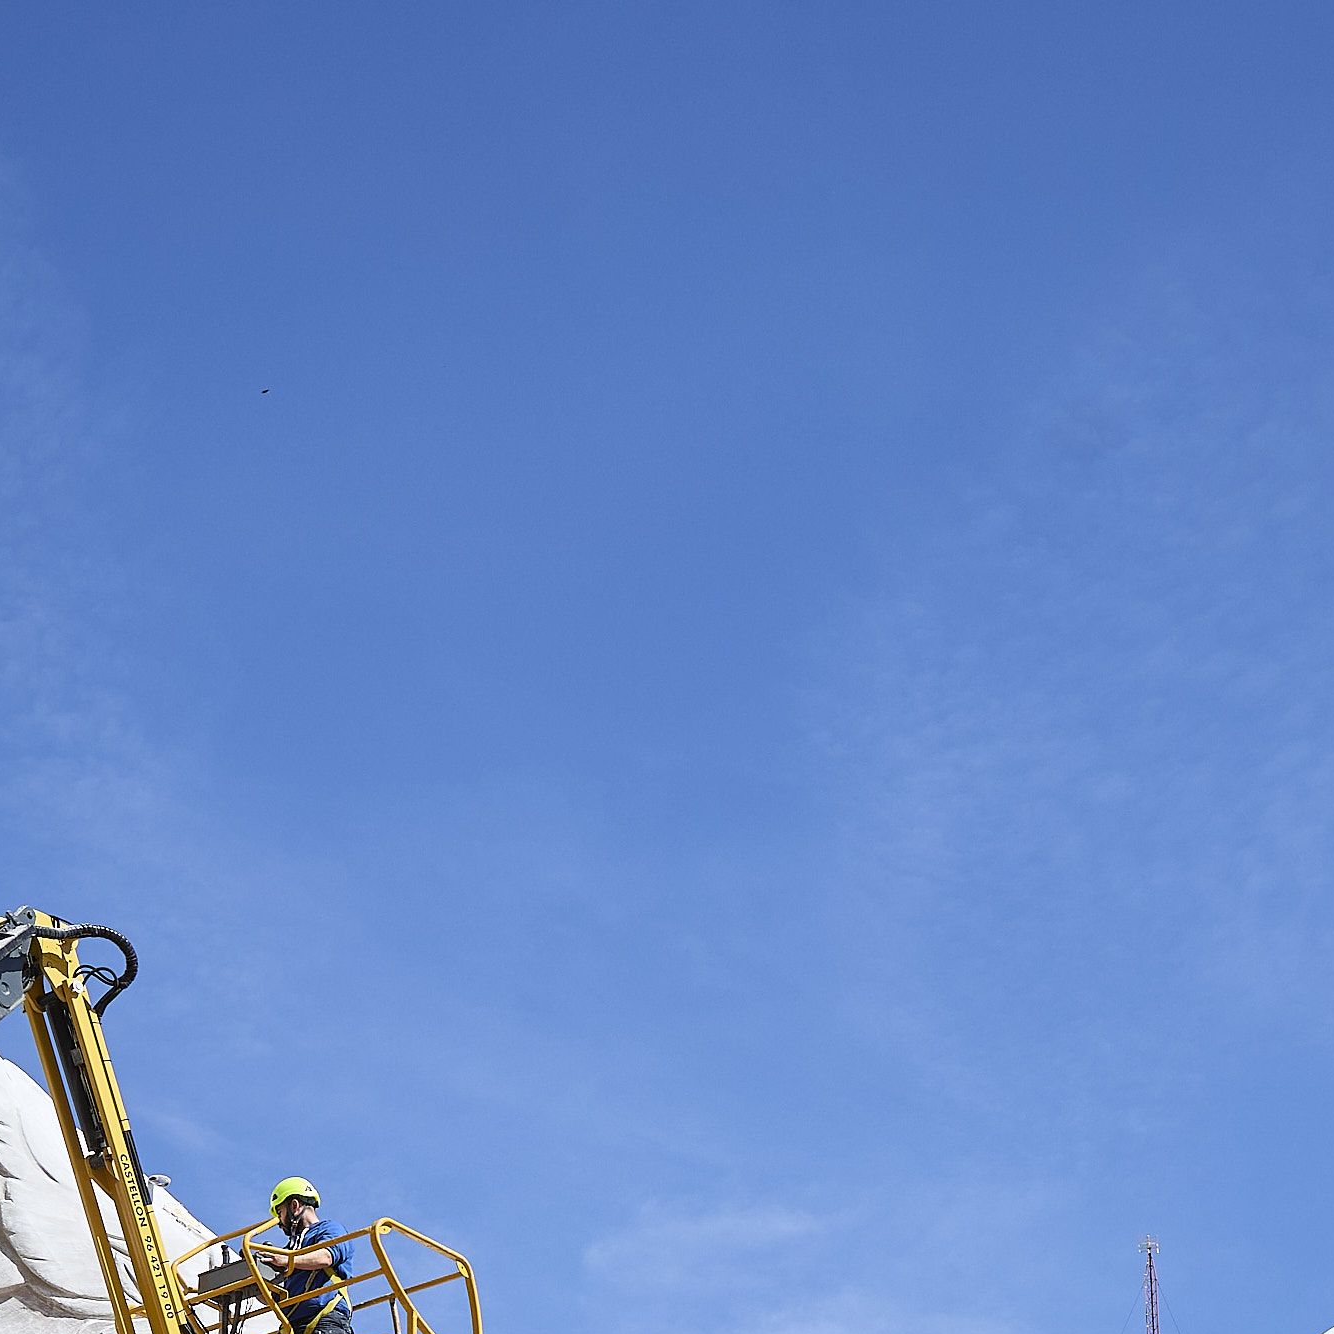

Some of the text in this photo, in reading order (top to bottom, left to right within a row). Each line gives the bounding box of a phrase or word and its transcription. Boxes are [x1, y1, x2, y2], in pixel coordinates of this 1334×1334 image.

[120, 1154, 174, 1319] CASTELLON 96 421 19 00
